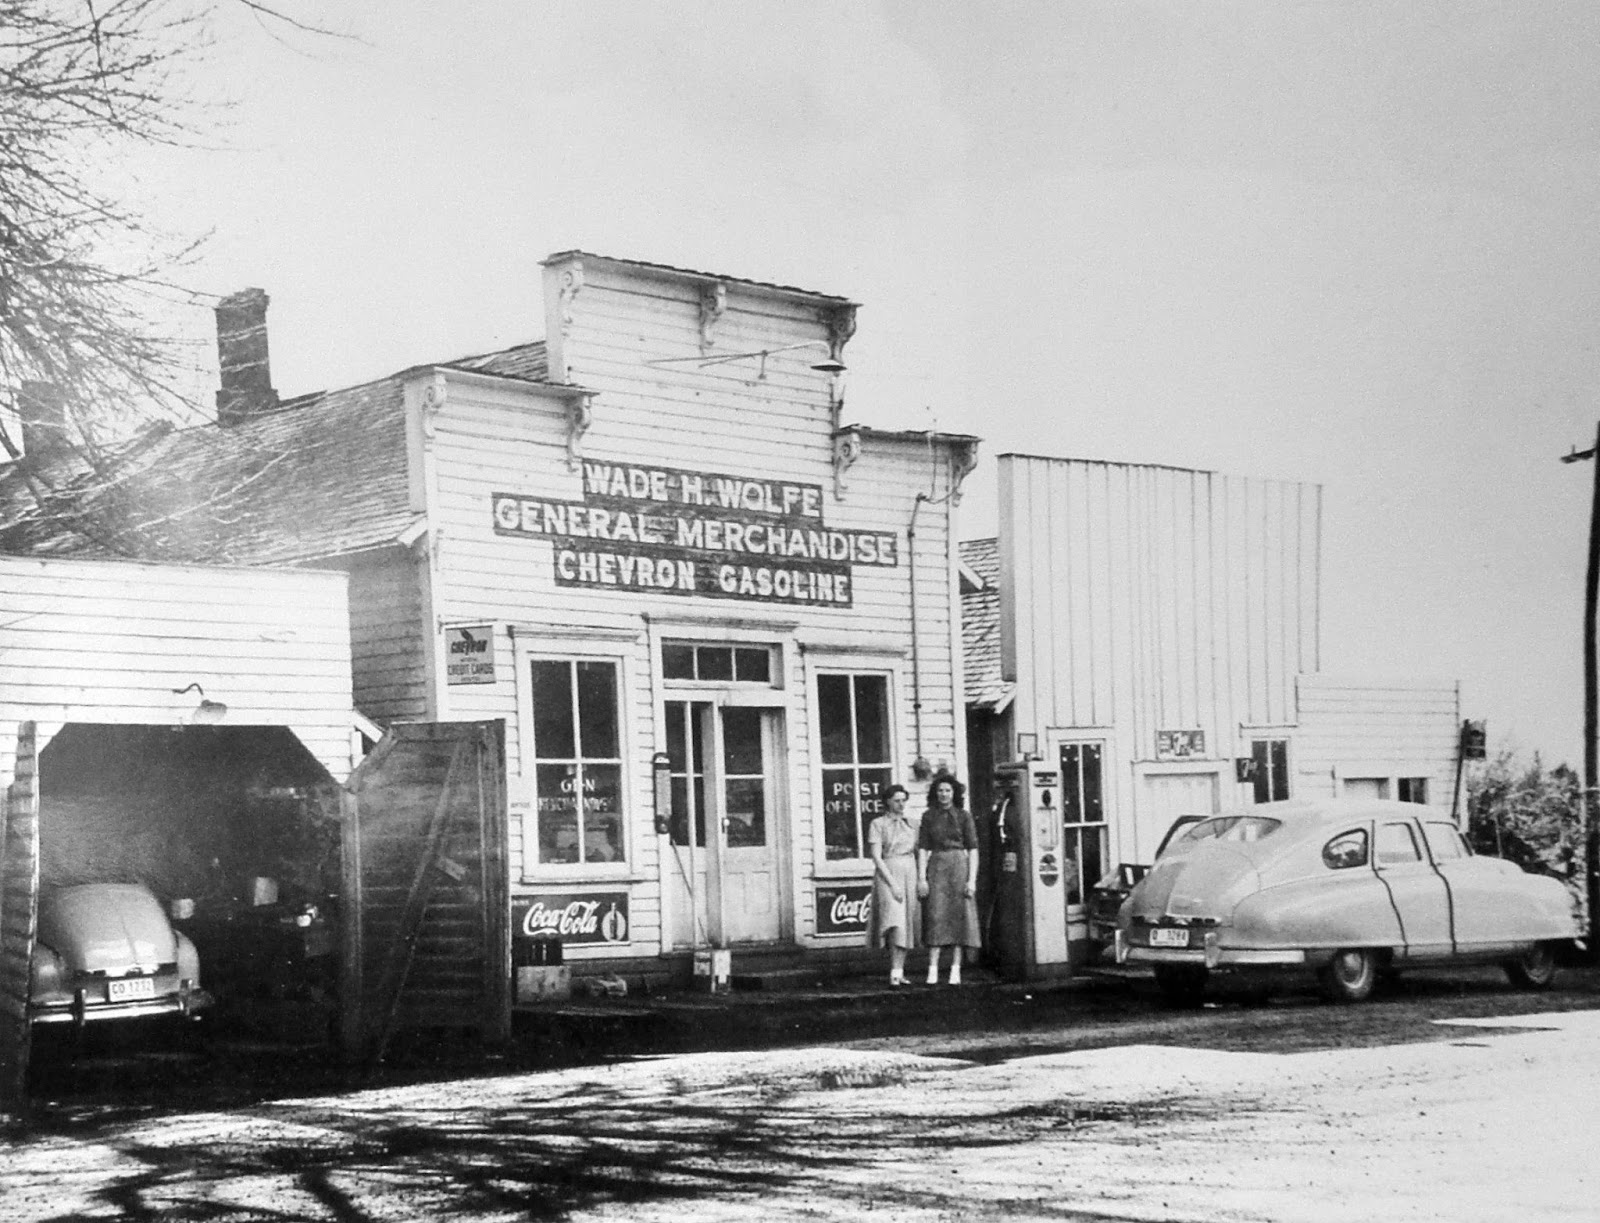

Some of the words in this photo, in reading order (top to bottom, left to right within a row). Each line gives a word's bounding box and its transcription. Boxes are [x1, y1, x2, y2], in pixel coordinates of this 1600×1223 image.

[585, 462, 669, 501] WADE
[717, 478, 821, 518] WOLFE
[494, 497, 659, 545] GENERAL
[675, 517, 898, 566] MERCHANDISE
[558, 549, 697, 591] CHEVRON
[717, 564, 850, 603] GASOLINE
[523, 900, 601, 935] Coca-Cola
[830, 894, 873, 925] Coca-C
